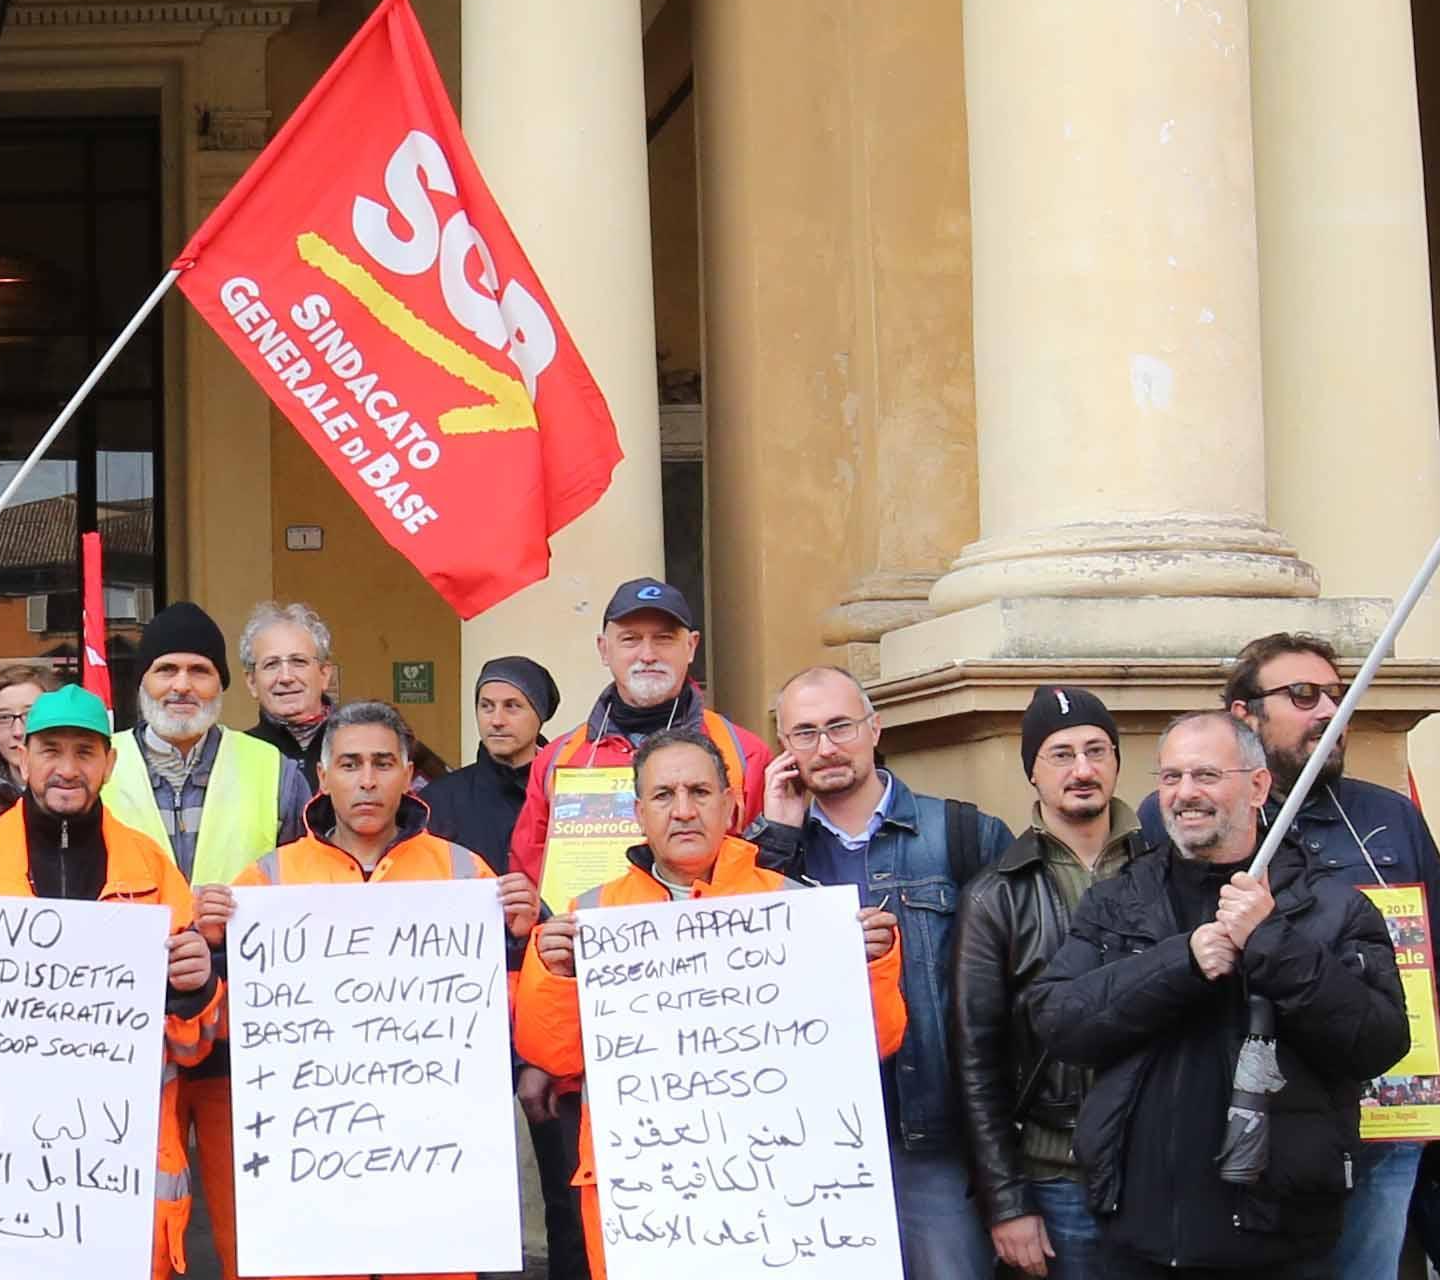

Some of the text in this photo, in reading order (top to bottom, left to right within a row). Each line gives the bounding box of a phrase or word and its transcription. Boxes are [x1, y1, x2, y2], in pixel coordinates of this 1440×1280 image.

[290, 292, 440, 471] SINDACATO
[219, 275, 359, 441] GENERALE
[358, 452, 438, 536] BASE
[1387, 905, 1415, 914] 2017
[324, 924, 375, 958] LE
[388, 922, 485, 961] MANI
[577, 902, 792, 960] BASTA APPALTI
[584, 943, 786, 989] ASSEGNATI CON
[244, 980, 313, 1008] DAL
[594, 983, 780, 1018] IL CRITERIO
[240, 1011, 478, 1050] BASTA TAGLI!
[595, 1018, 829, 1062] DEL MASSIMO
[40, 1038, 134, 1064] SOCIALI
[292, 1058, 462, 1092] EDUCATORI
[617, 1067, 788, 1106] RIBASSO
[103, 1099, 131, 1145] لا
[292, 1101, 385, 1137] ATA
[833, 1101, 865, 1150] لا
[290, 1143, 463, 1183] DOCENTI
